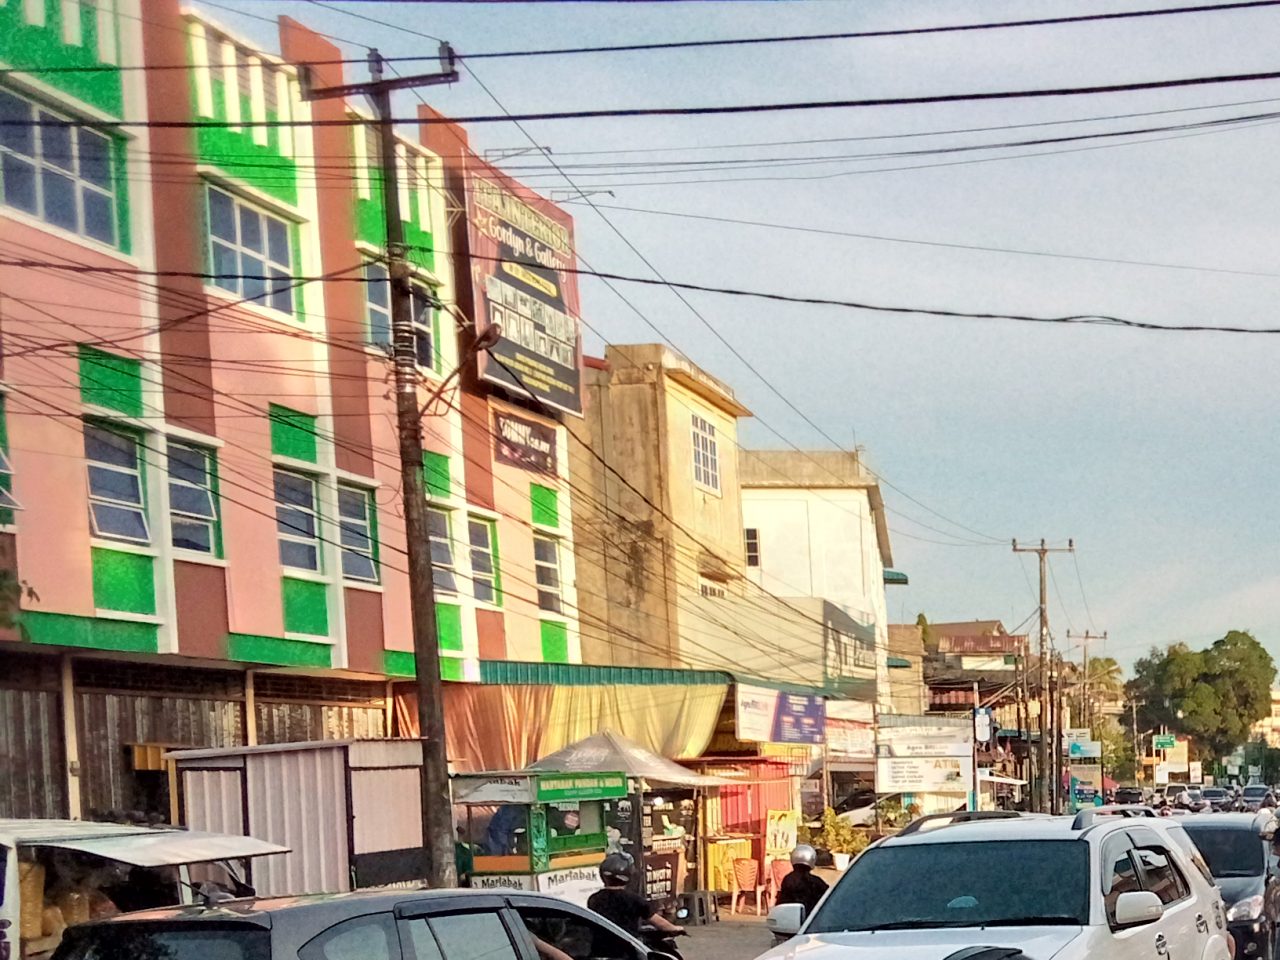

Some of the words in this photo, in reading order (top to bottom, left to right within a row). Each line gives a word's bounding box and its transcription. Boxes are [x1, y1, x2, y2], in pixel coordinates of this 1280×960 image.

[488, 216, 525, 257] Gordyn
[525, 238, 533, 257] &
[481, 878, 524, 890] Martabak
[547, 868, 598, 889] Martabak
